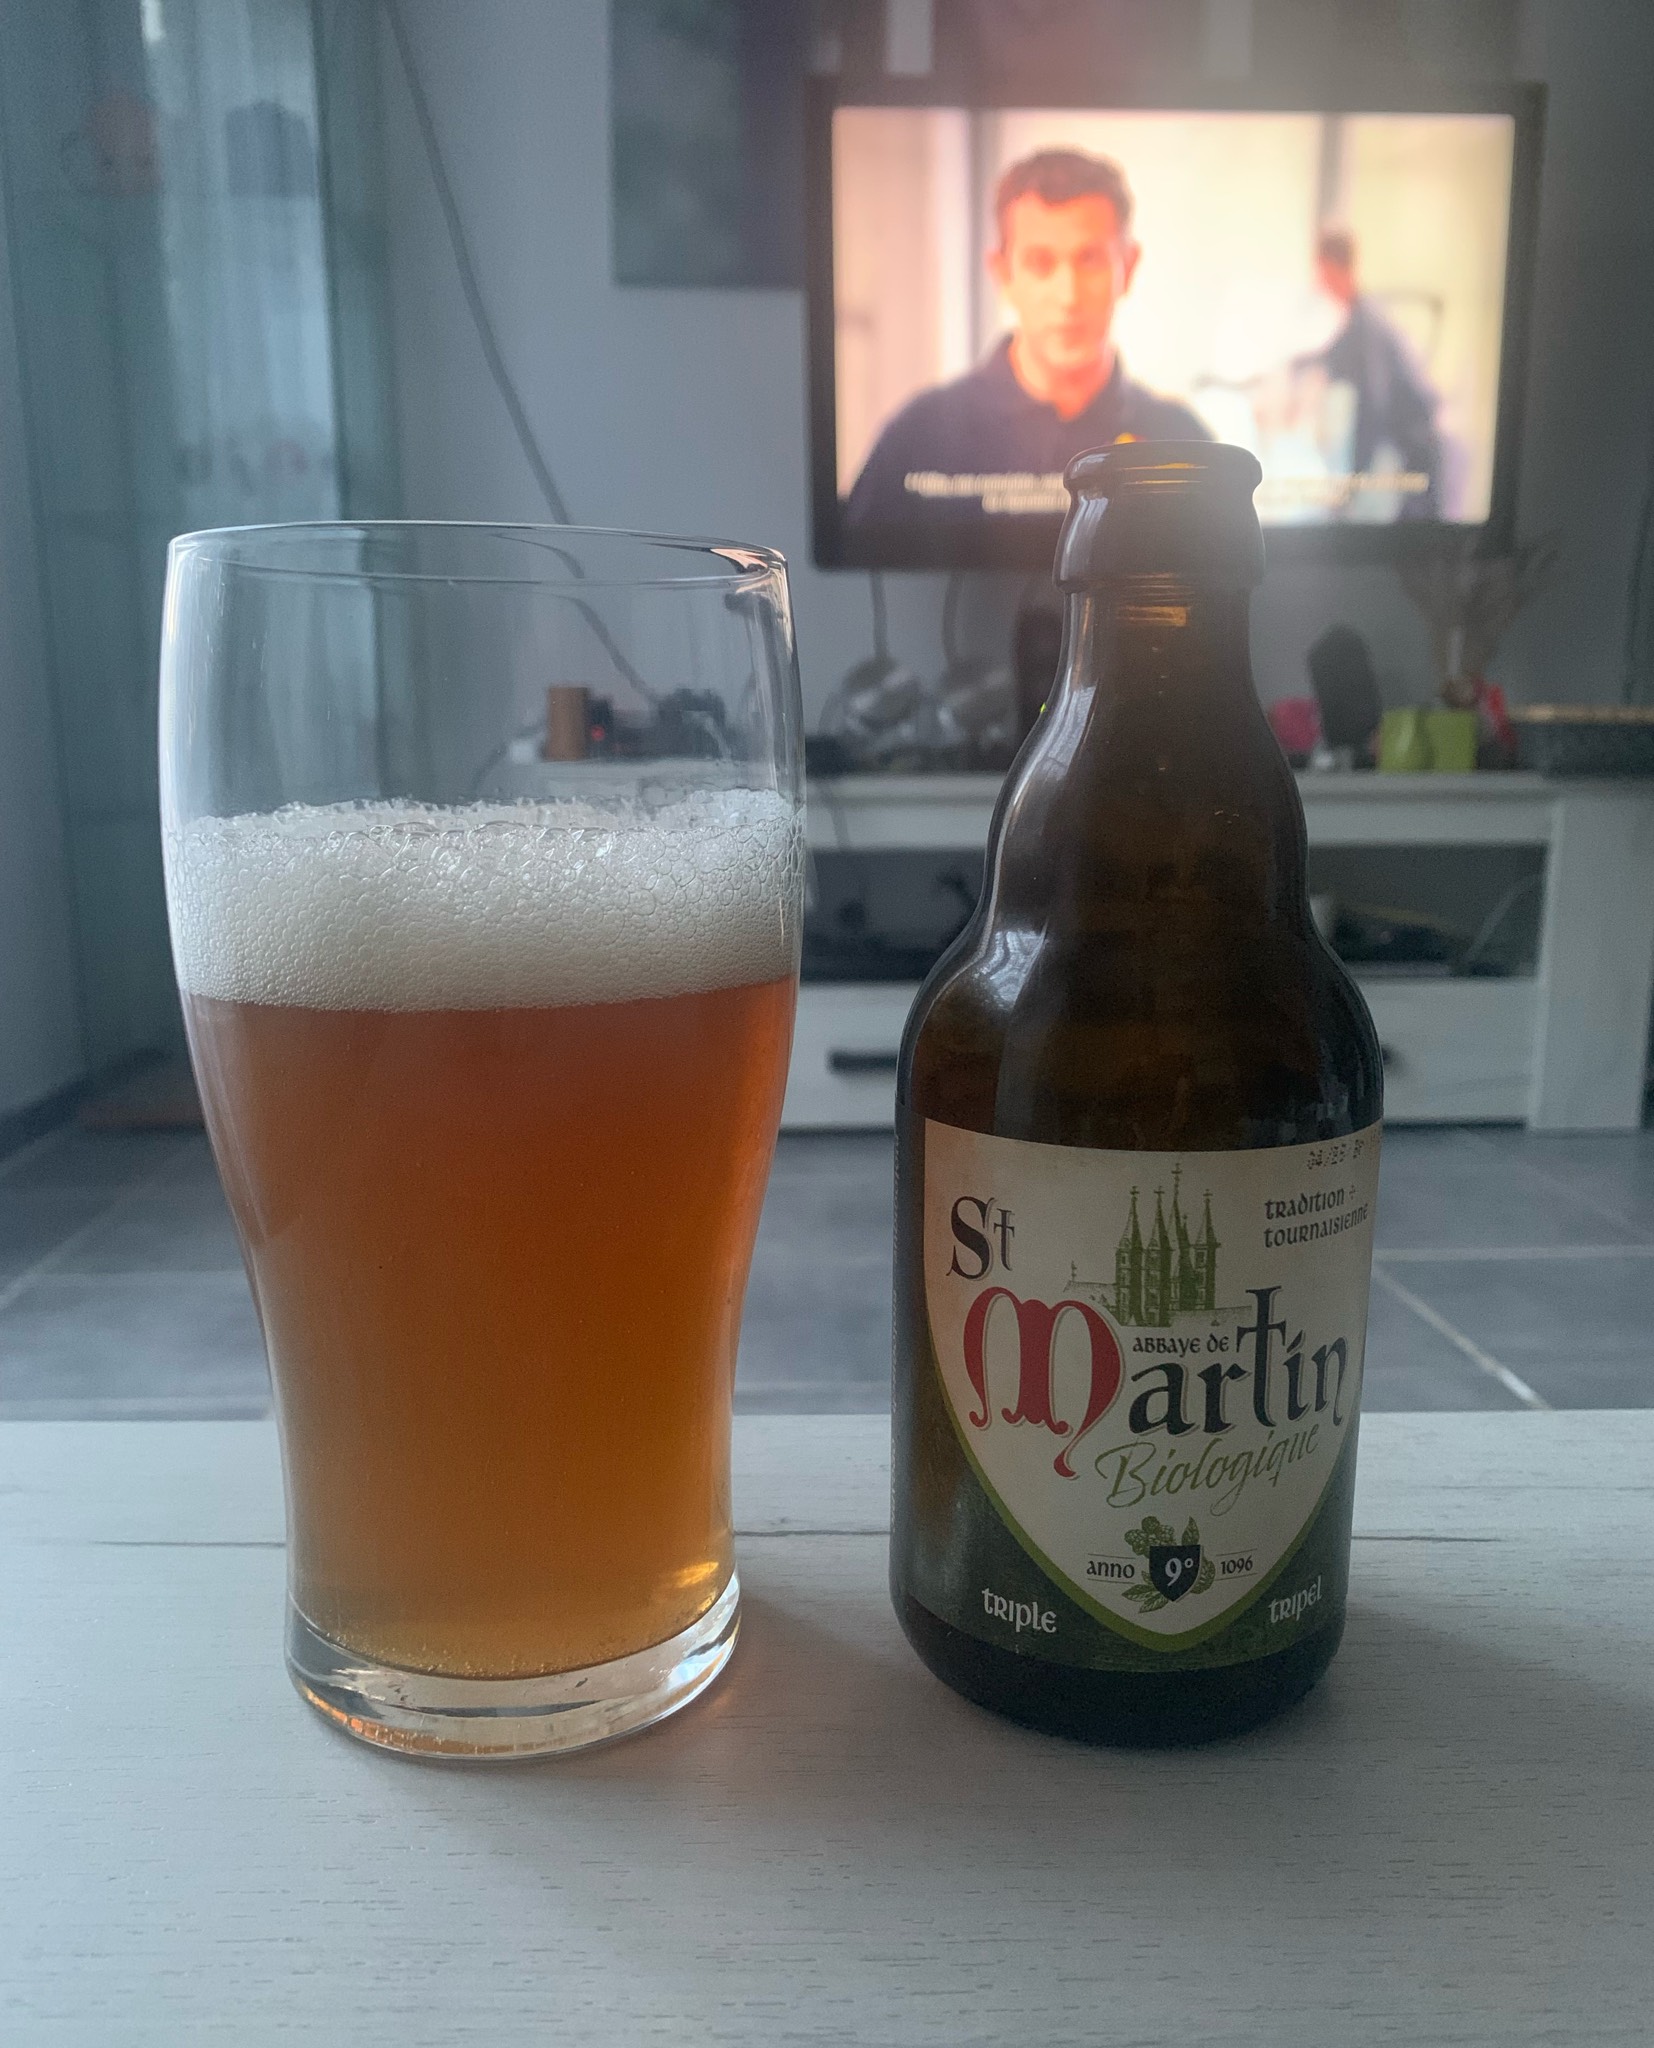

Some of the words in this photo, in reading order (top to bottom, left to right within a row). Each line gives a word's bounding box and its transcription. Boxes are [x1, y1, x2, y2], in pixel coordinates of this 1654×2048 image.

[1263, 1203, 1369, 1248] tournaisienne
[1264, 1187, 1345, 1220] tradition
[945, 1195, 1016, 1281] St
[1132, 1337, 1201, 1356] abbaye
[1206, 1333, 1230, 1353] de
[963, 1286, 1350, 1478] Martin
[1094, 1424, 1320, 1517] Biologique
[1086, 1558, 1136, 1580] anno
[1220, 1556, 1255, 1575] 1096
[981, 1588, 1058, 1633] triple
[1268, 1576, 1323, 1624] tripel
